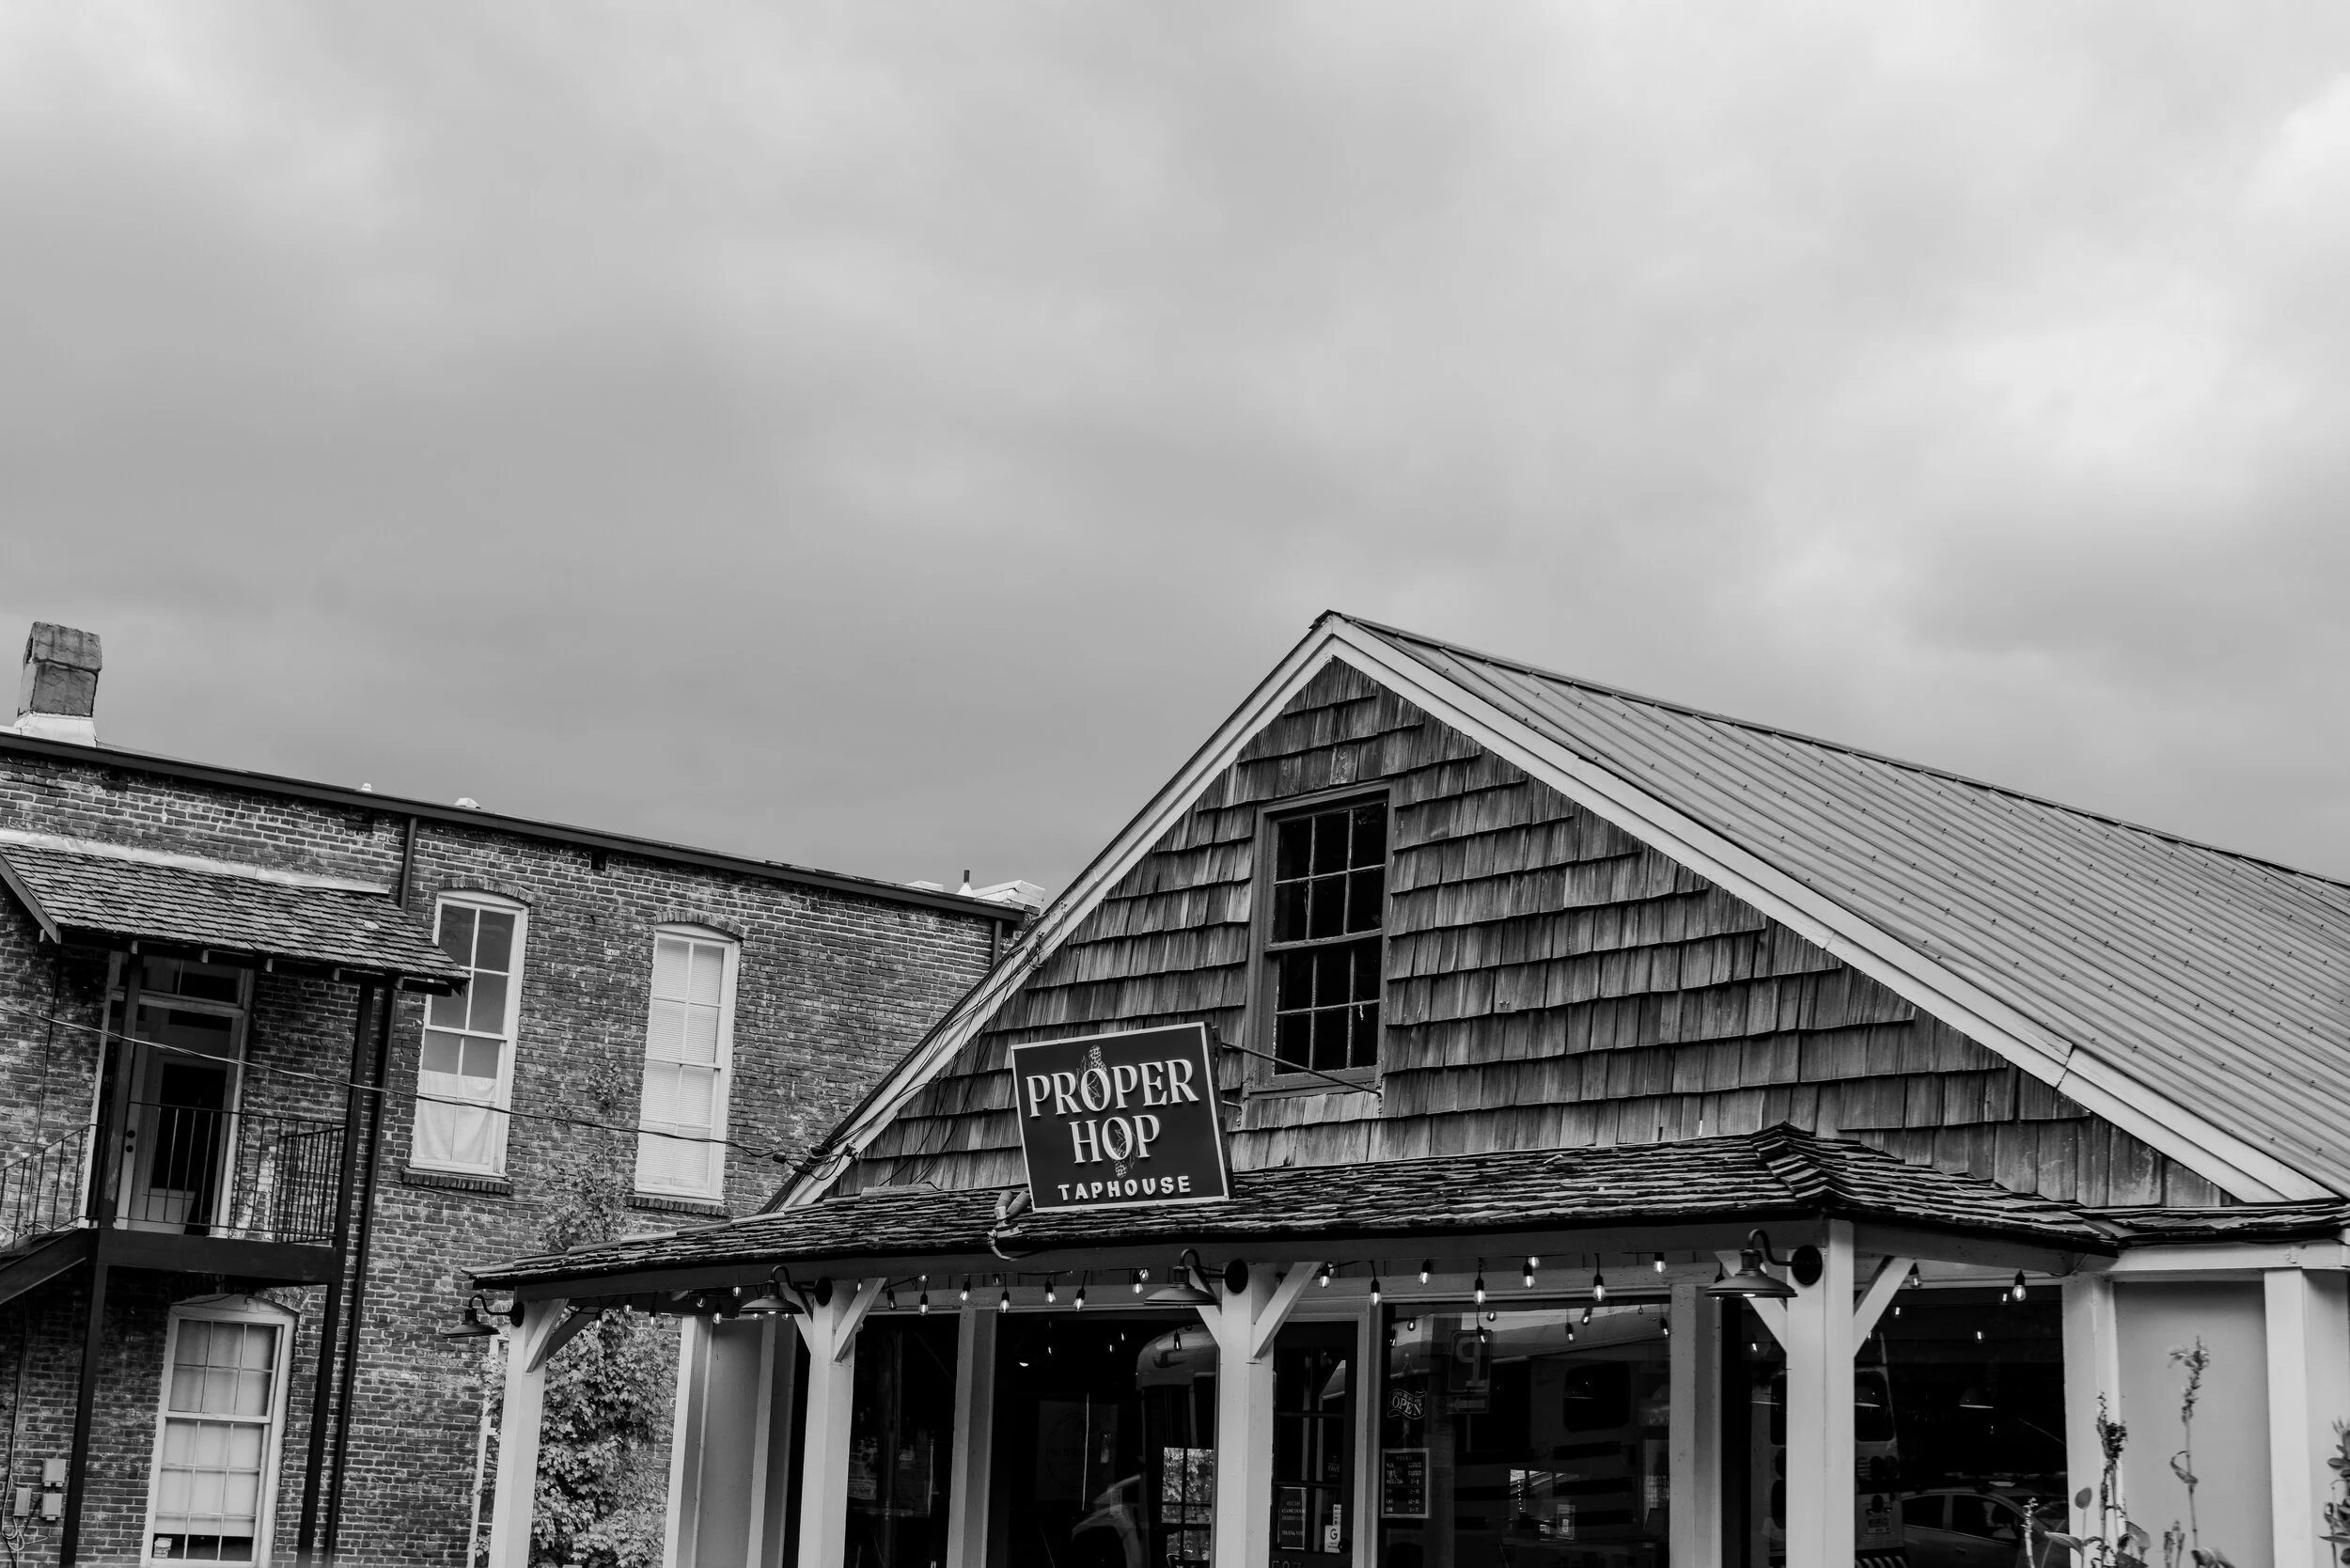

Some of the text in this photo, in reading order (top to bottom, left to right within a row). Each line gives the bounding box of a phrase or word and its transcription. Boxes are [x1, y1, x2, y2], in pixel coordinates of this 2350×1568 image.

[1026, 1058, 1200, 1118] PROPER
[1069, 1114, 1160, 1164] HOP
[1058, 1175, 1191, 1200] TAPHOUSE
[1392, 1395, 1421, 1416] OPEN
[1329, 1528, 1338, 1541] G
